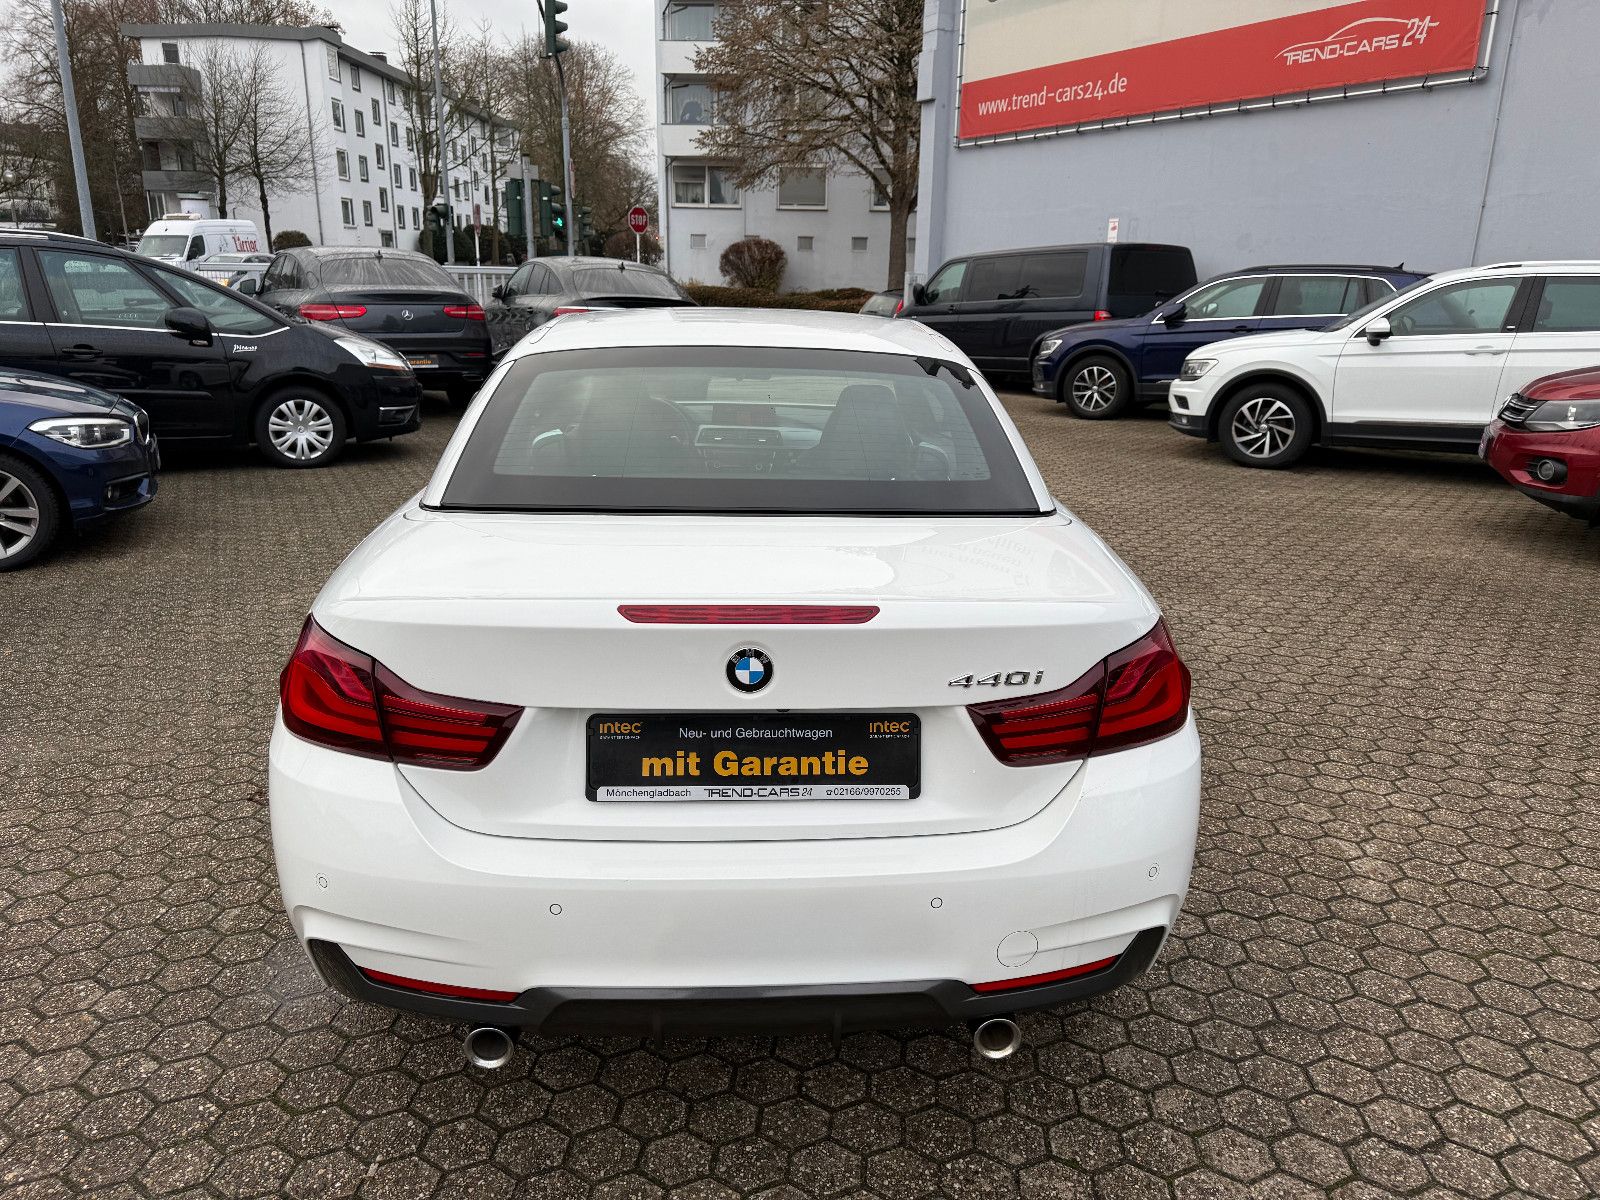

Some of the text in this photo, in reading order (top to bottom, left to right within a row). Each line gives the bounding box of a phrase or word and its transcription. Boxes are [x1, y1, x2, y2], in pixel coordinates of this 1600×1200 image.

[978, 72, 1127, 116] www.trend-cars24.de
[630, 214, 647, 226] STOP
[948, 670, 1044, 688] 440i
[599, 721, 642, 734] intec
[869, 720, 911, 733] intec
[679, 727, 833, 741] Neu- und Gebrauchtwagen
[641, 749, 869, 777] mit Garantie
[606, 788, 692, 798] Mönchengladbach
[801, 787, 813, 797] 24
[833, 787, 901, 796] 02166/9970255
